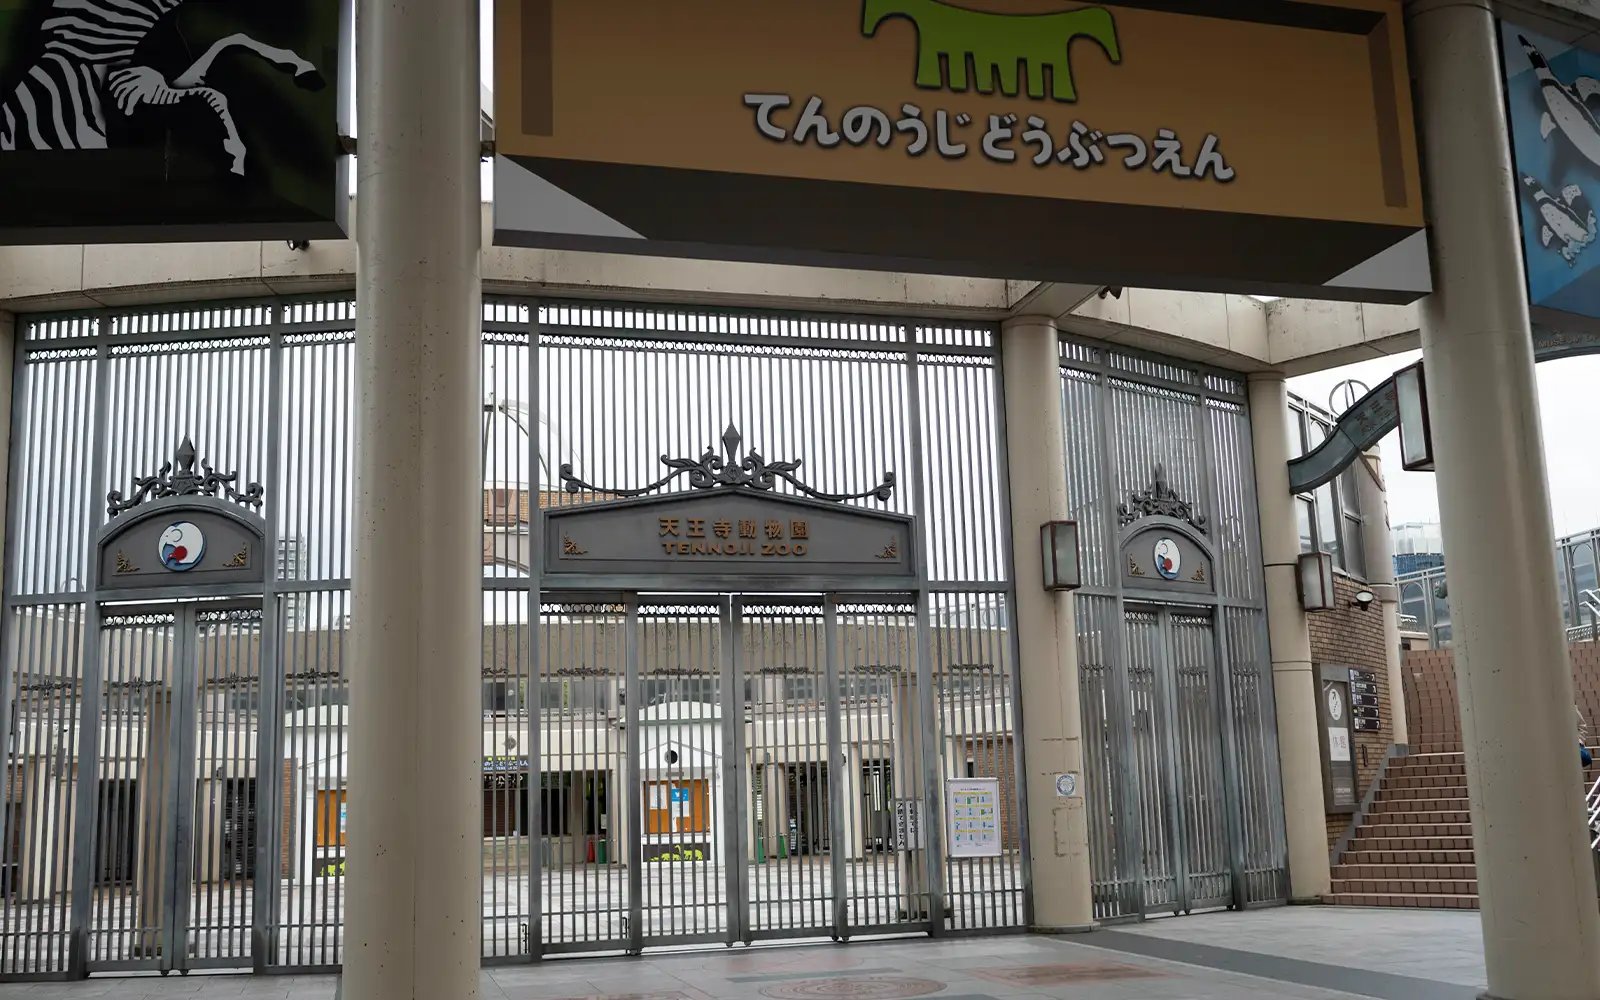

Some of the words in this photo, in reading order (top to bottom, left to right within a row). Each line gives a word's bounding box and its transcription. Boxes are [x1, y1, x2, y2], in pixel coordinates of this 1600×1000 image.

[744, 93, 1235, 181] てんのうじどうぶつえん
[658, 517, 809, 540] 天王寺動物園
[662, 541, 755, 556] TENNOJI
[761, 543, 808, 556] ZOO
